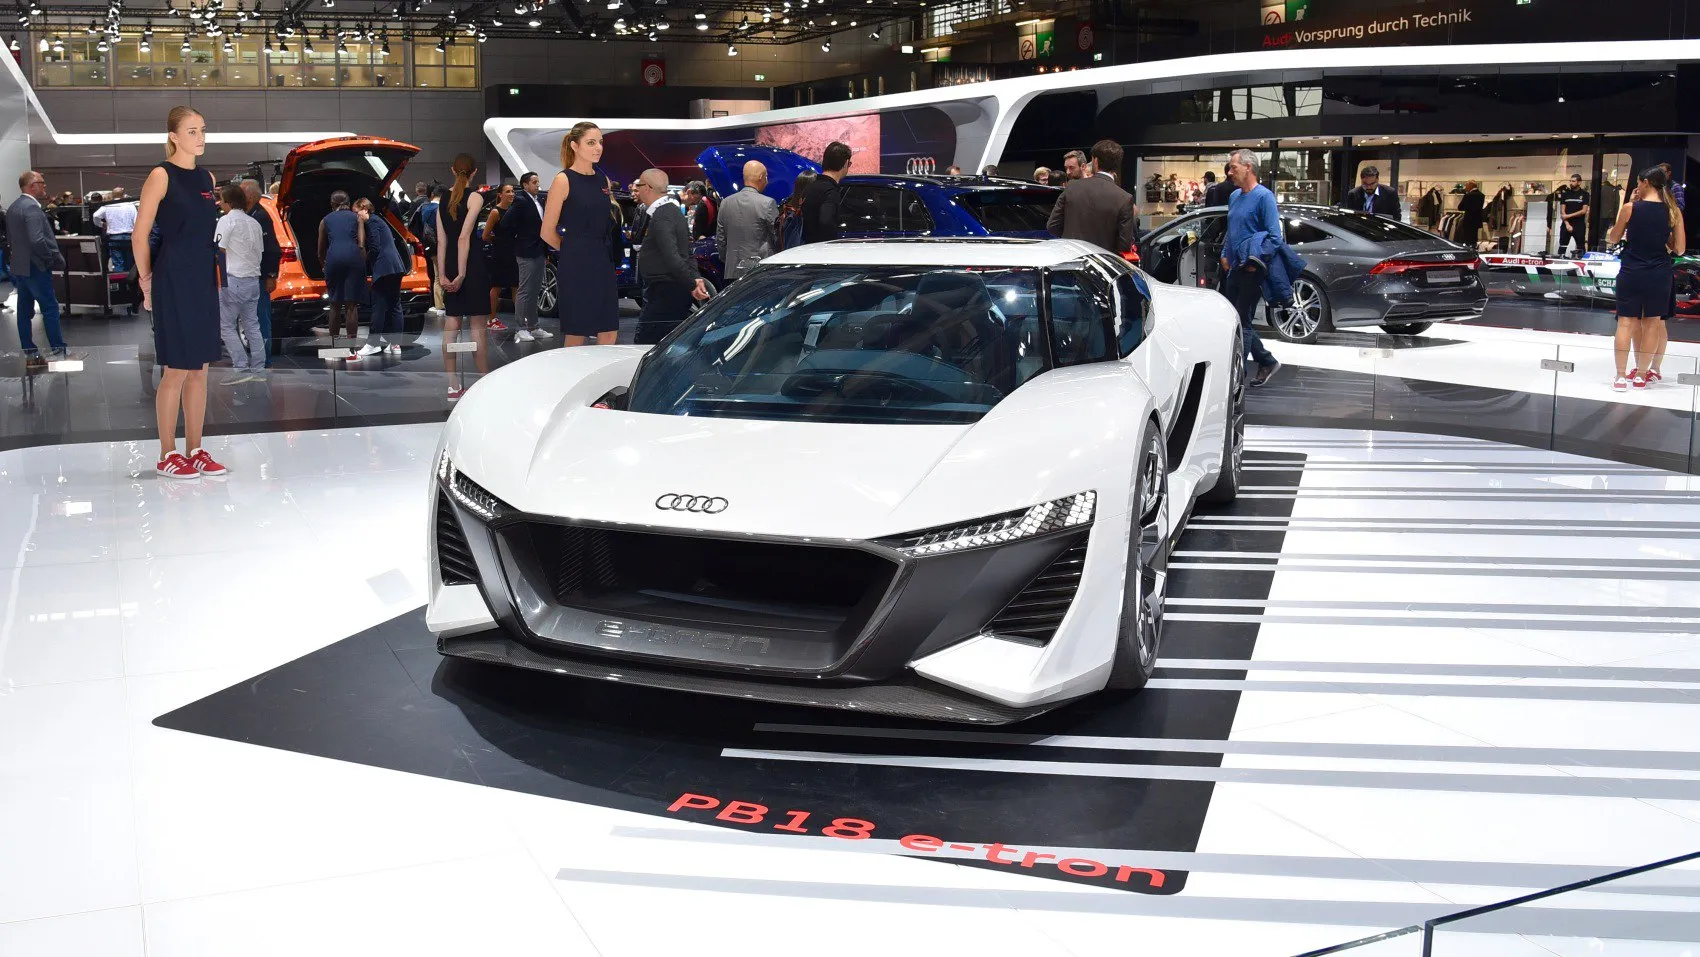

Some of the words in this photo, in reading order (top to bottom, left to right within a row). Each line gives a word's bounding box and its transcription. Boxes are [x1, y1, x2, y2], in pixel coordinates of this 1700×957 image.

[1295, 25, 1364, 43] Vorsprung
[1368, 17, 1409, 35] durch
[1413, 9, 1472, 28] Technik
[666, 792, 876, 840] PB18
[900, 834, 1166, 888] e-tron
